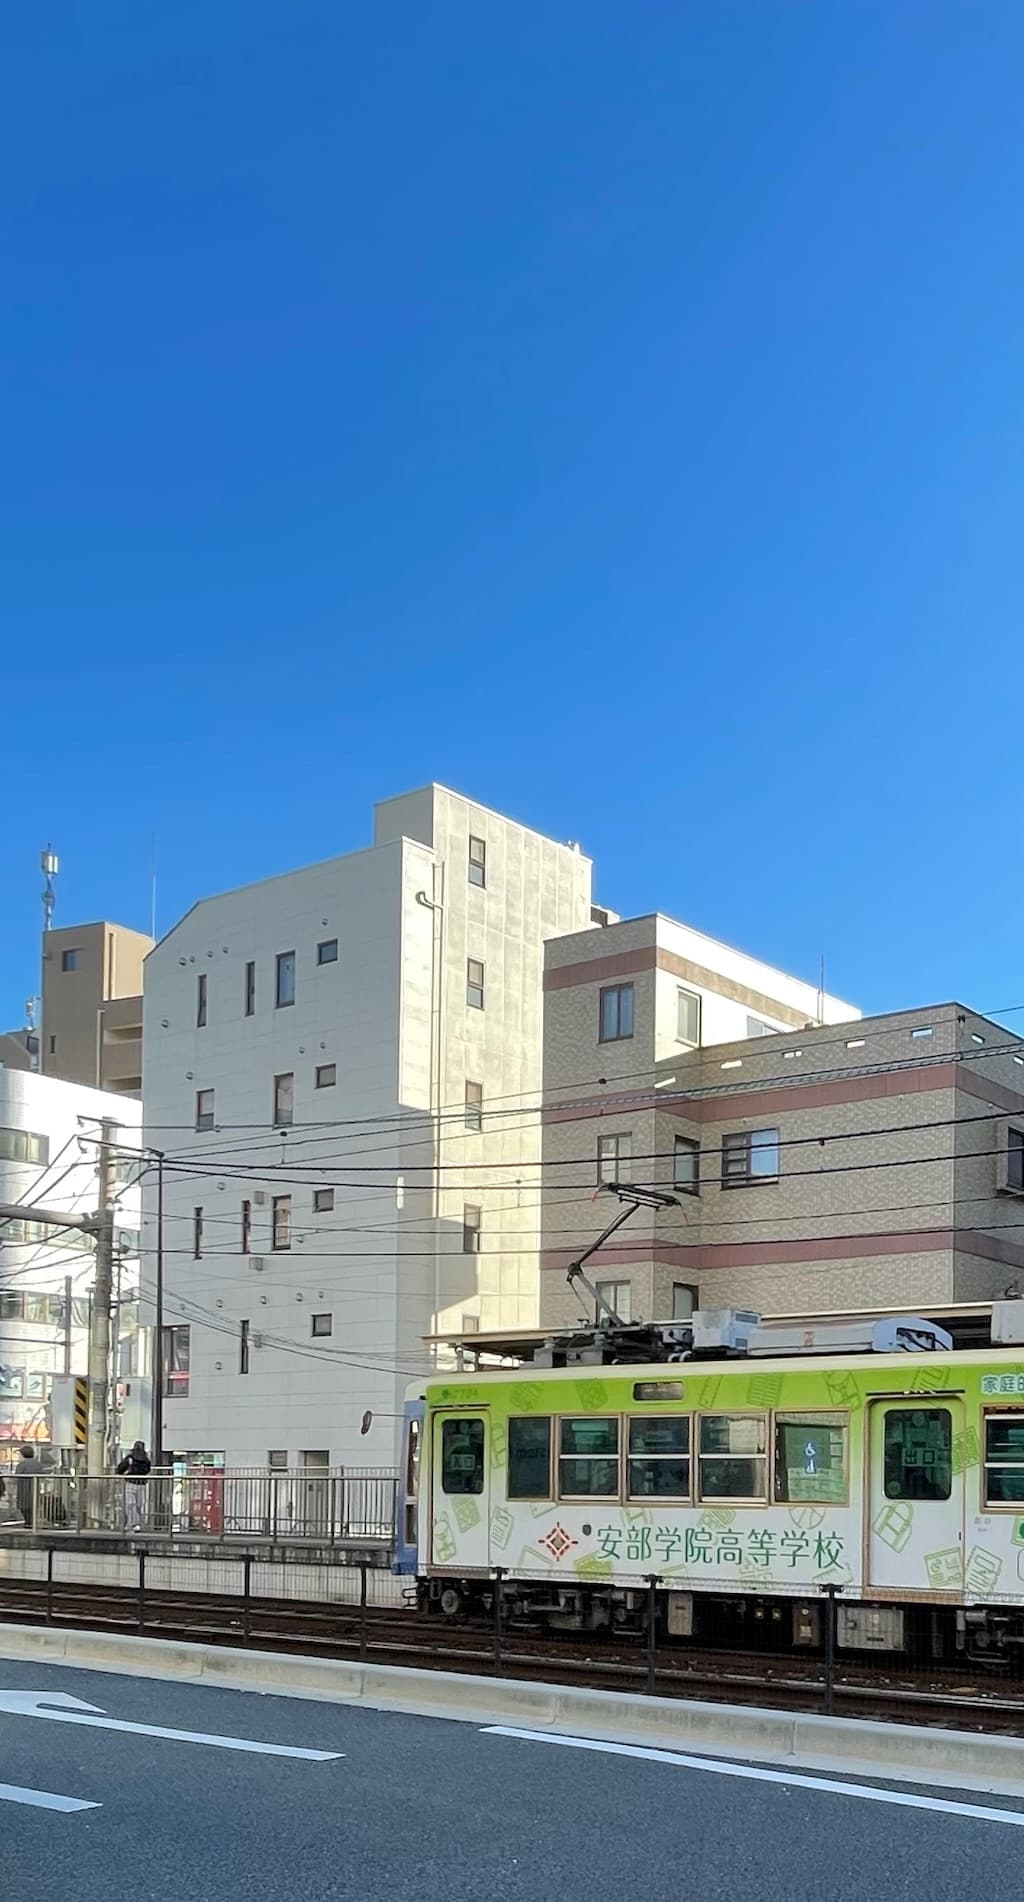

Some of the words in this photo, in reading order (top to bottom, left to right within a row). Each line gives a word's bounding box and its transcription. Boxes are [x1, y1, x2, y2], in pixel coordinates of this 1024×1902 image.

[597, 1525, 845, 1570] 安部学院高等学校
